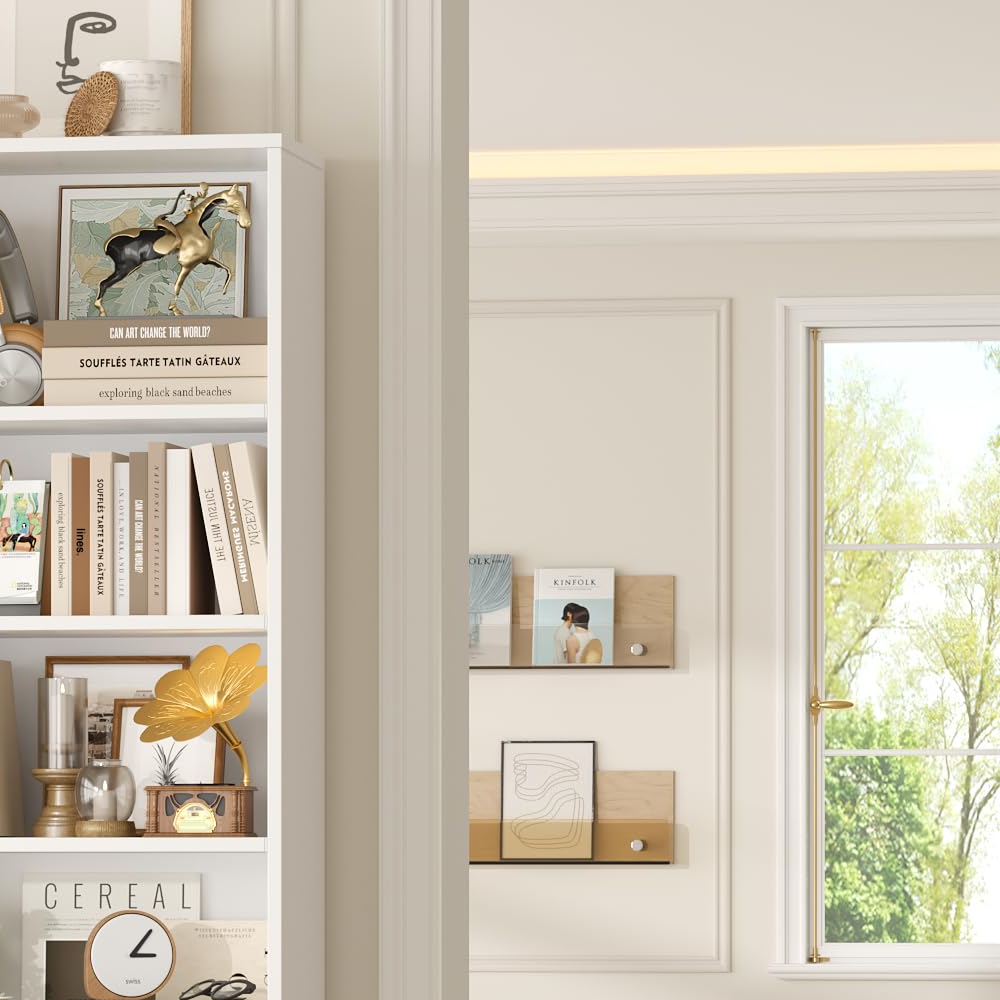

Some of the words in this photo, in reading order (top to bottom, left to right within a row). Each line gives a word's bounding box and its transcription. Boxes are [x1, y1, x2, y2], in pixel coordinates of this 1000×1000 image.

[109, 326, 124, 339] CAN
[125, 326, 139, 338] ART
[140, 325, 167, 338] CHANGE
[168, 325, 181, 337] THE
[182, 325, 211, 337] WORLD?
[79, 355, 127, 367] SOUFFLÉS
[130, 357, 160, 367] TARTE
[165, 356, 192, 366] TATIN
[195, 354, 241, 366] GÂTEAUX
[98, 388, 143, 400] exploring
[145, 387, 170, 397] black
[172, 387, 194, 397] sand
[195, 386, 232, 397] beaches
[96, 478, 105, 513] SOUFFLÉS
[56, 491, 66, 527] exploring
[56, 527, 66, 544] black
[96, 514, 105, 538] TARTE
[134, 522, 143, 541] CHANGE
[56, 545, 66, 561] sand
[96, 539, 105, 560] TATIN
[56, 561, 66, 589] beaches
[96, 562, 105, 596] GÂTEAUX
[44, 882, 192, 910] CEREAL
